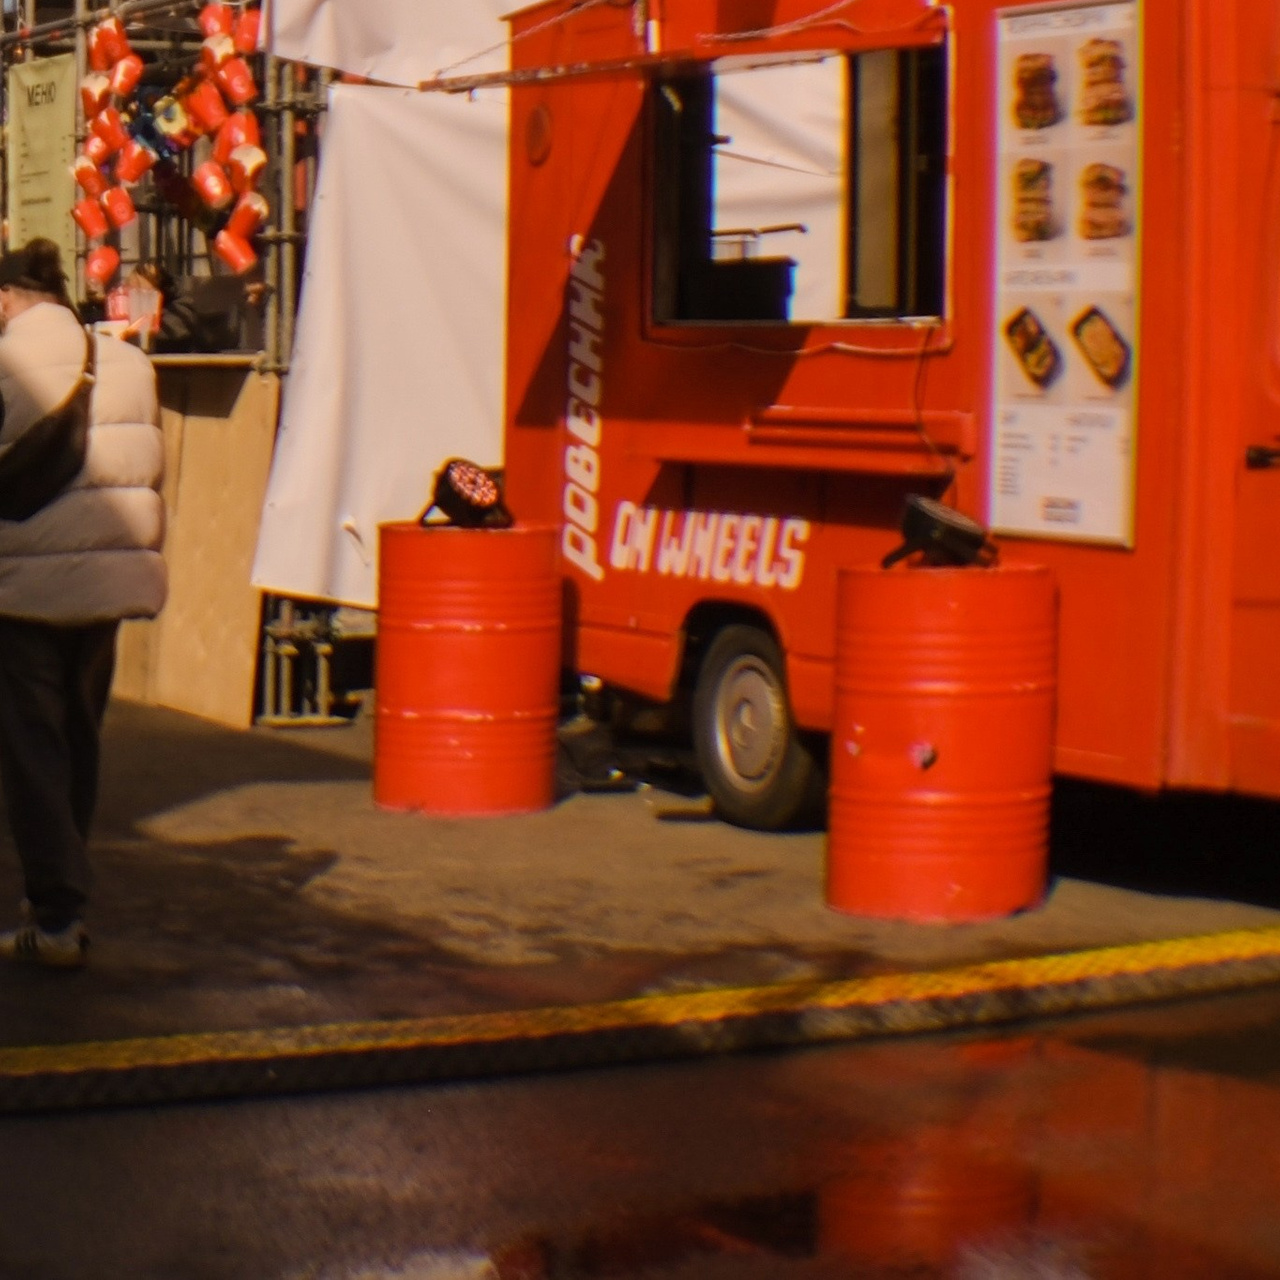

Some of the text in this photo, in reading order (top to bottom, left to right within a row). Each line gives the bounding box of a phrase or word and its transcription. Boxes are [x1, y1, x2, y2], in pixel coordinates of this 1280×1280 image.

[26, 81, 57, 108] МЕНЮ
[609, 498, 811, 590] ON WHEELS
